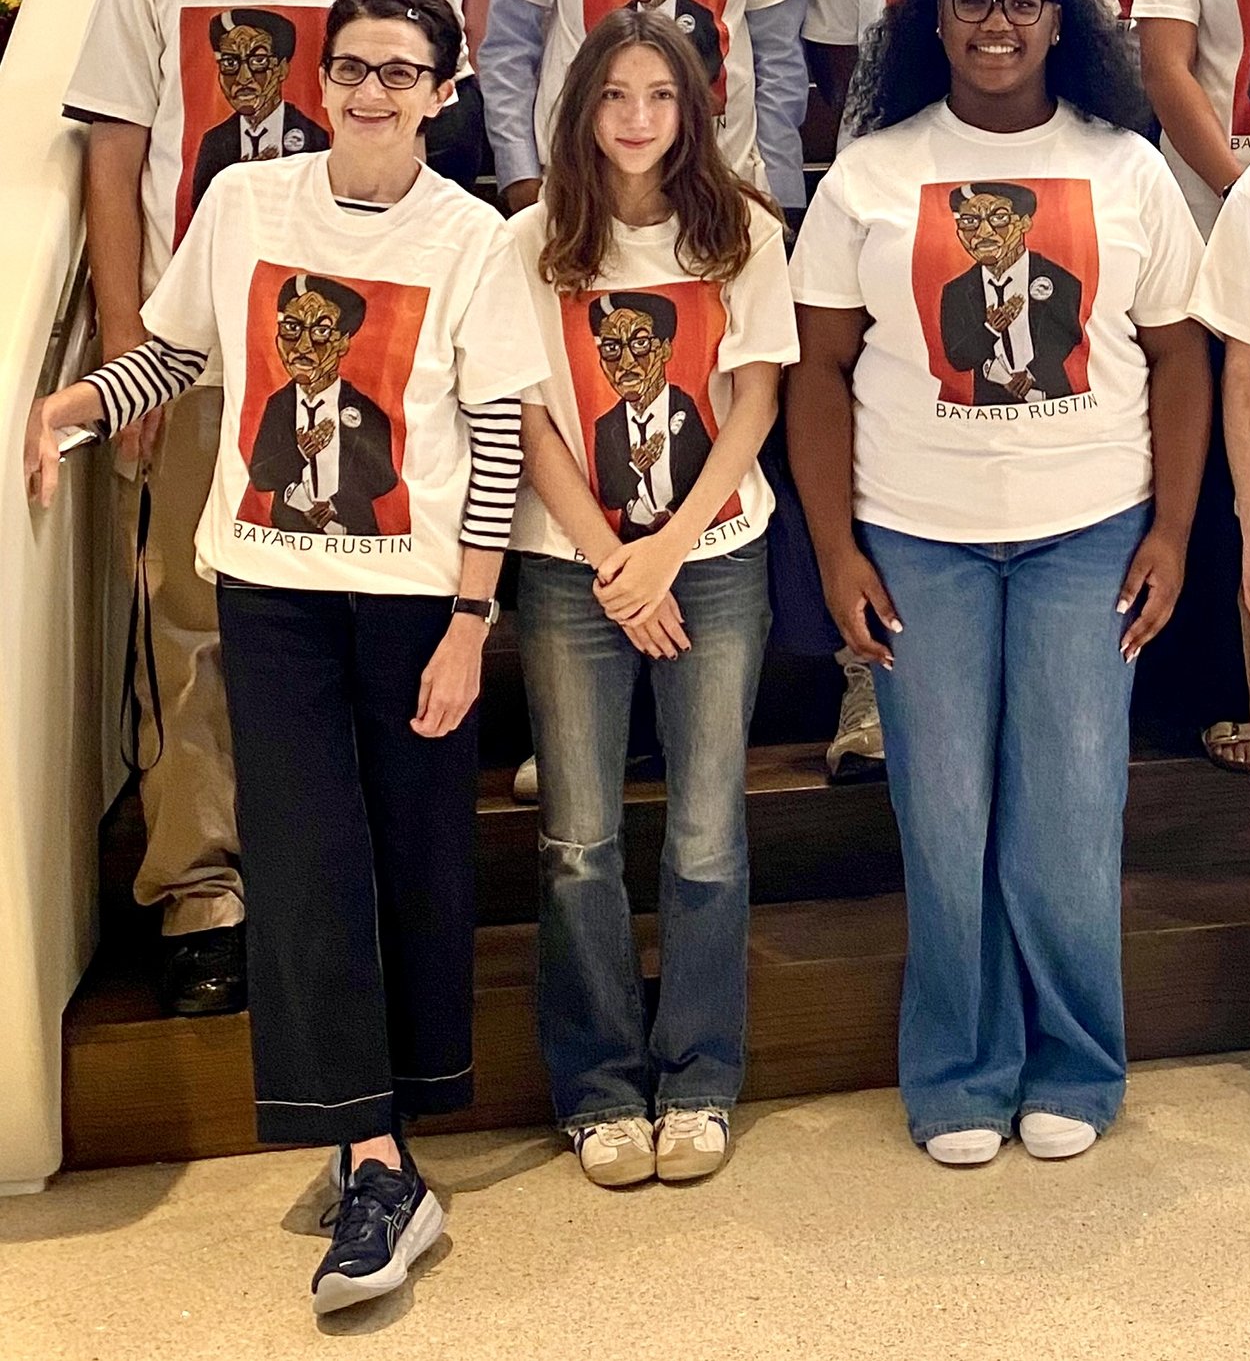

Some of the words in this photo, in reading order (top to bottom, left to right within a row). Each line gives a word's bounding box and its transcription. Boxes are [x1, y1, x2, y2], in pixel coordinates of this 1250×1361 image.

[936, 402, 1019, 421] BAYARD
[1028, 393, 1099, 419] RUSTIN
[233, 522, 313, 551] BAYARD
[325, 537, 412, 554] RUSTIN
